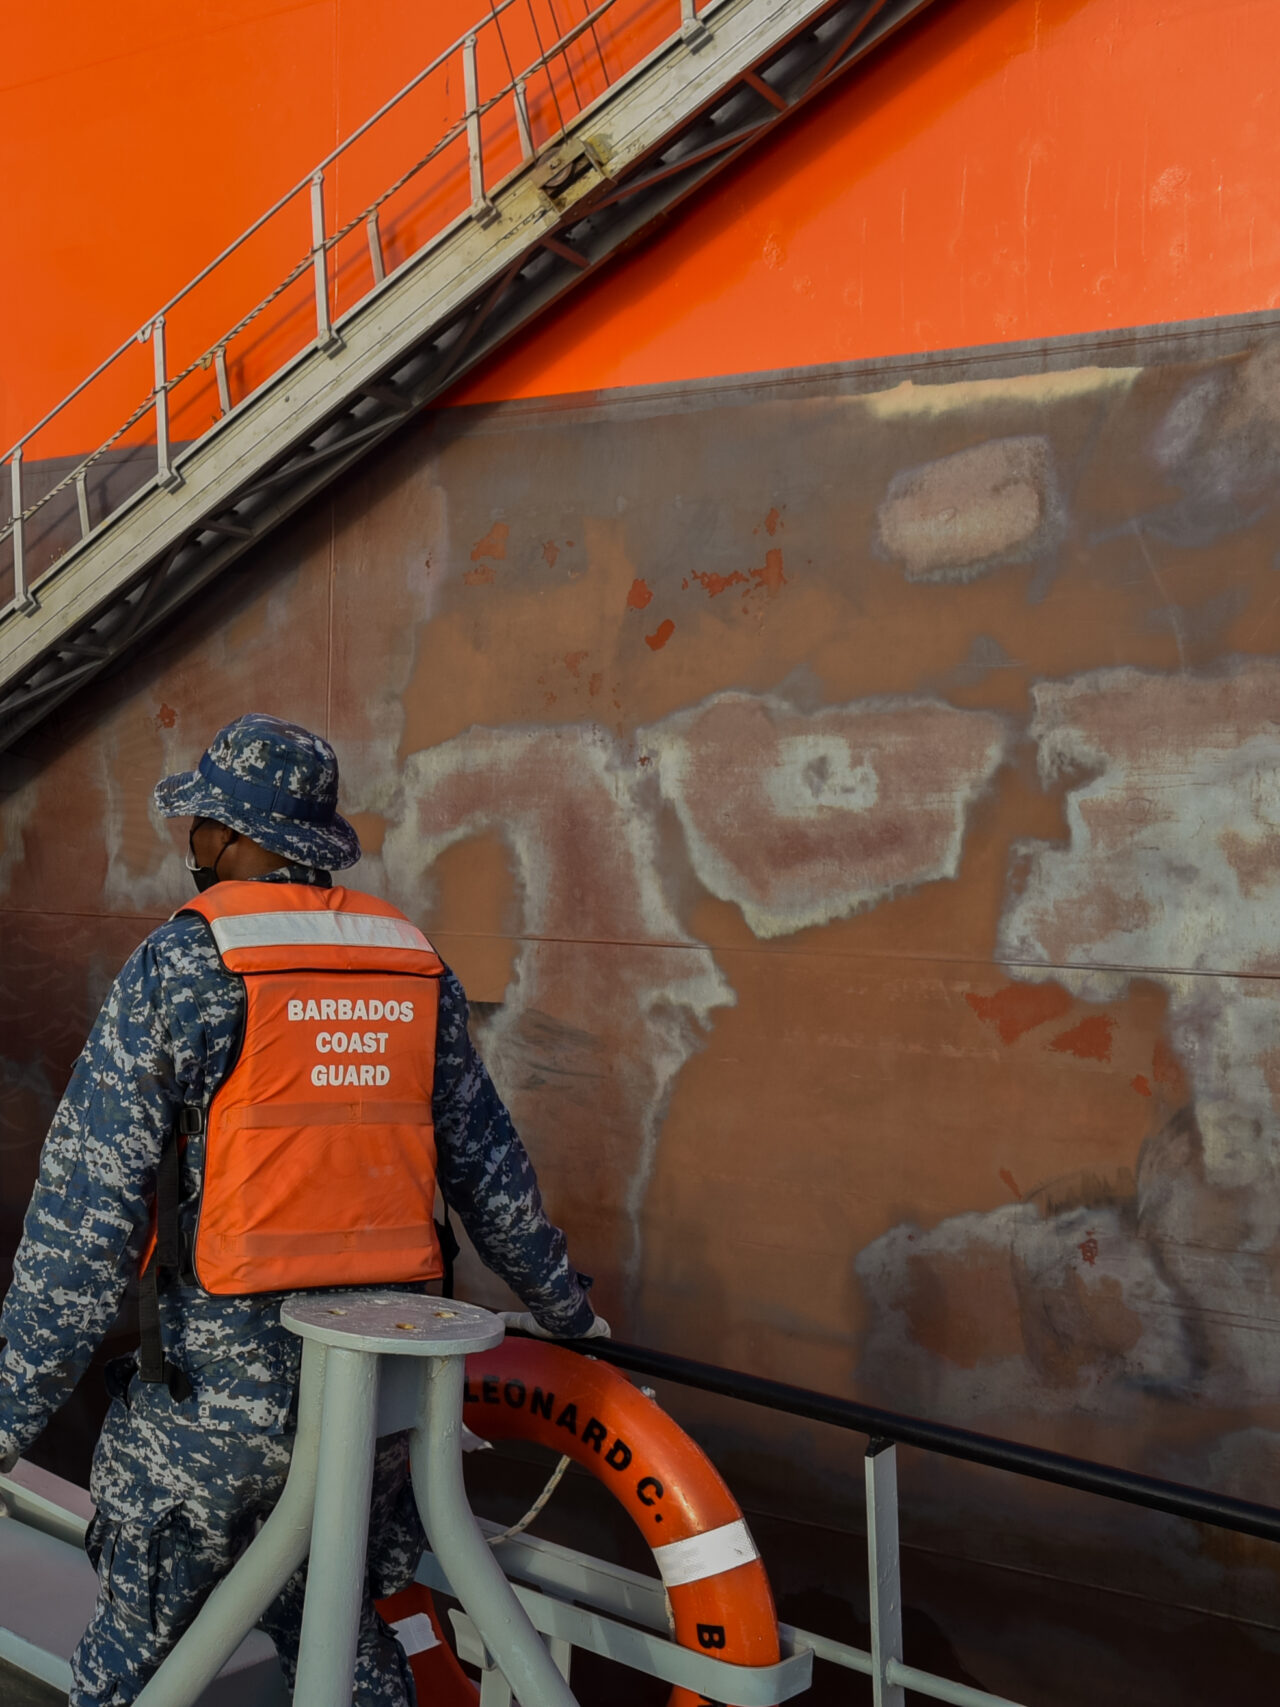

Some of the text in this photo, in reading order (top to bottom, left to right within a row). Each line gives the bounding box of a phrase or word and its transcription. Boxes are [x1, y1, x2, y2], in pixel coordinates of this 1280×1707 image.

[287, 998, 414, 1023] BARBADOS
[315, 1031, 389, 1054] COAST
[310, 1064, 391, 1087] GUARD
[463, 1374, 633, 1472] LEONARD
